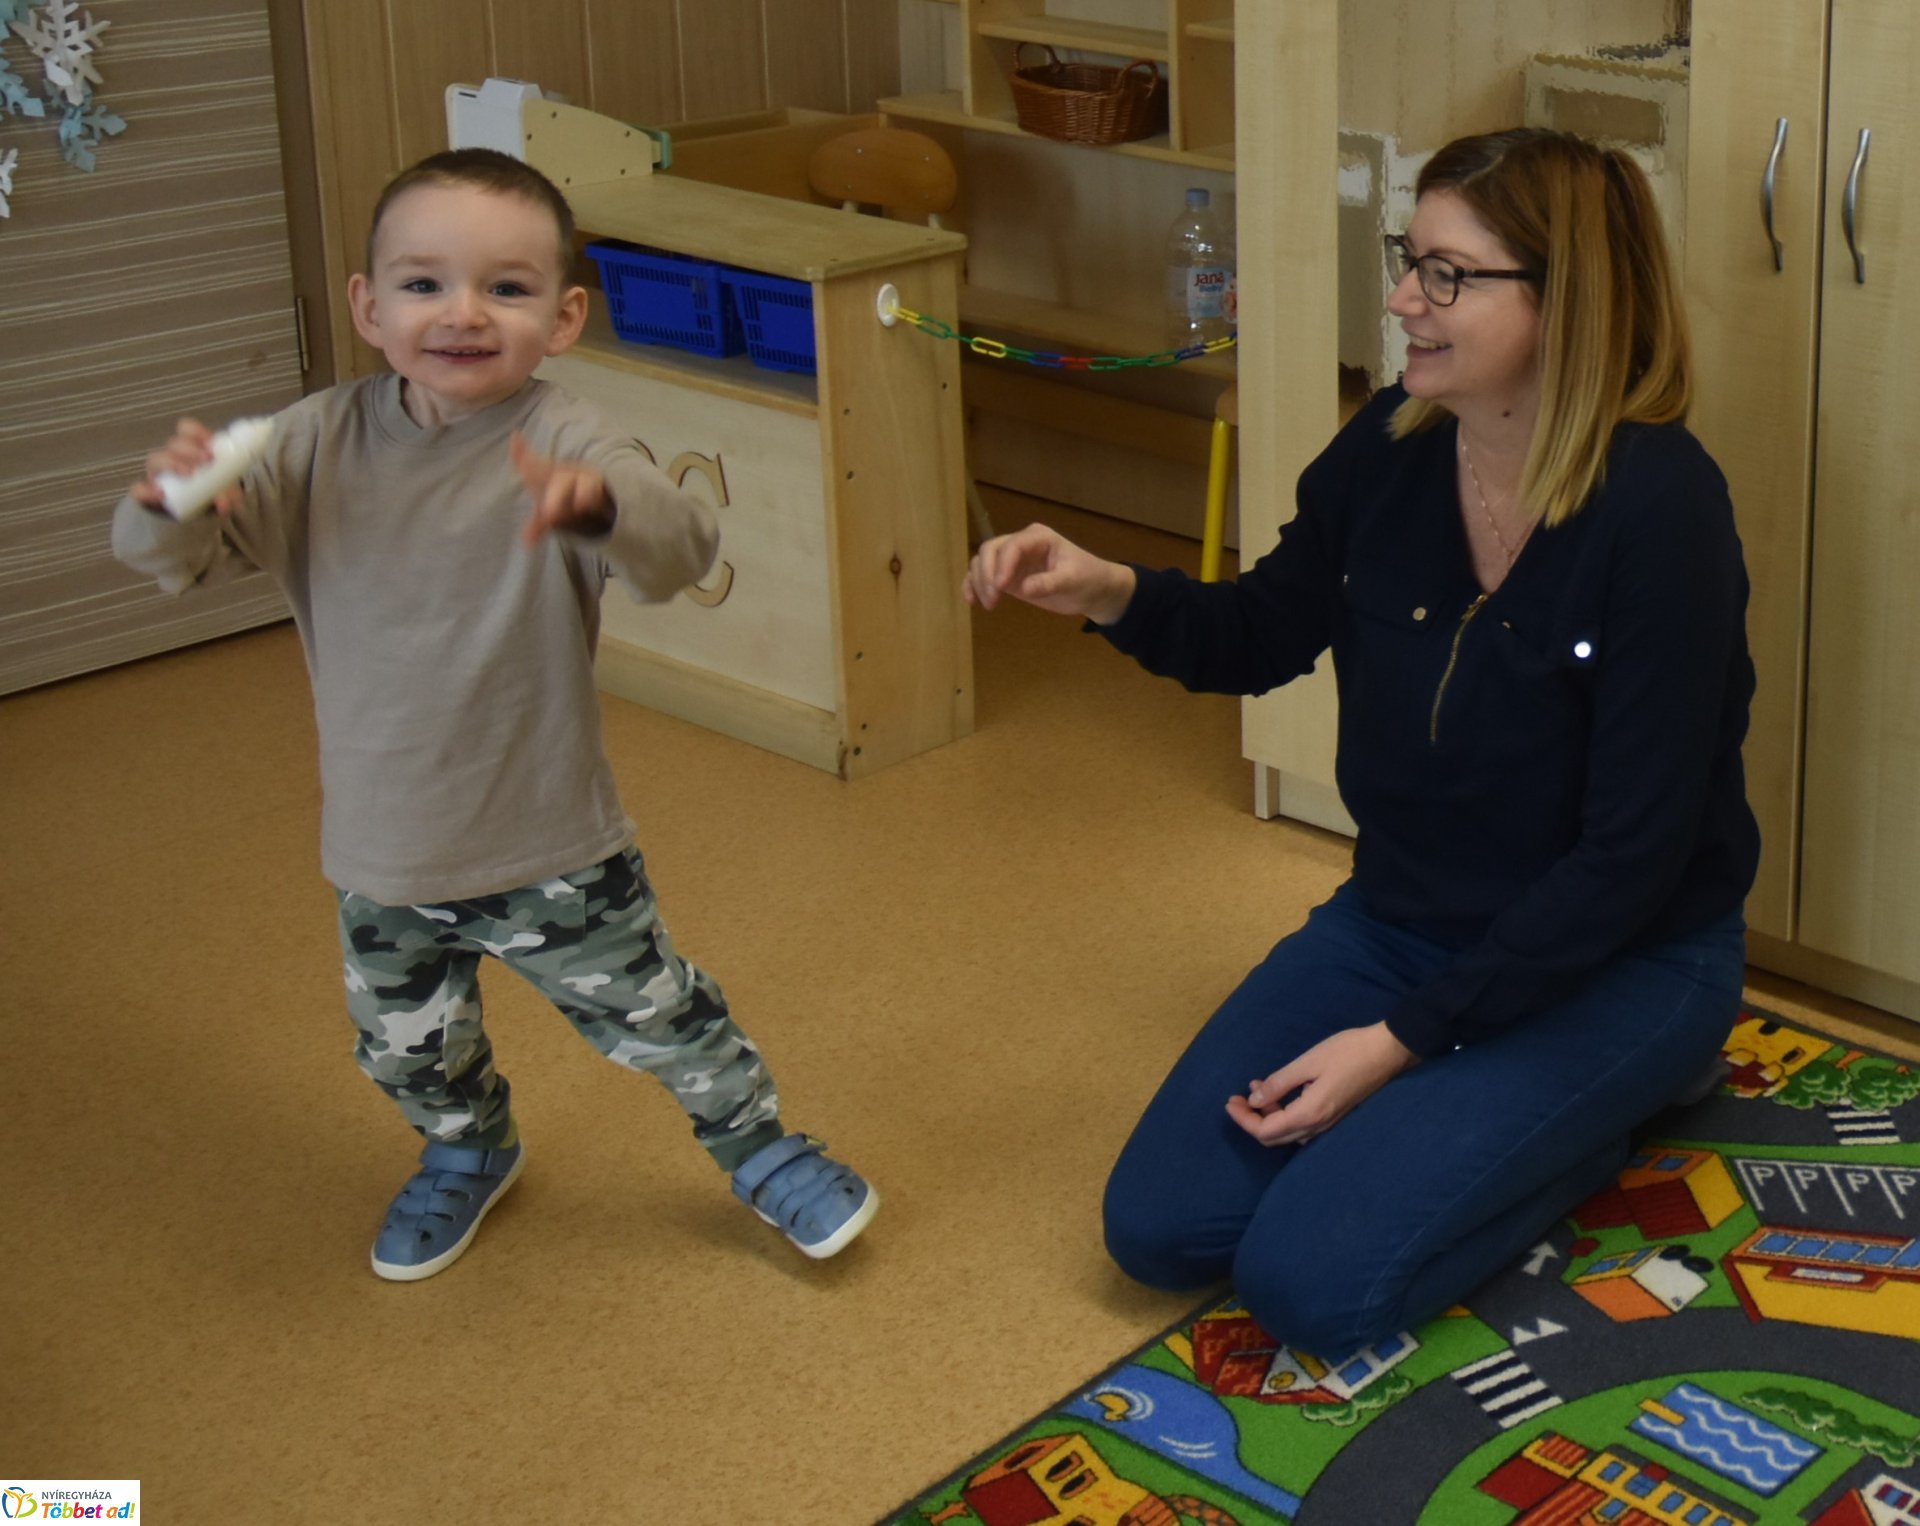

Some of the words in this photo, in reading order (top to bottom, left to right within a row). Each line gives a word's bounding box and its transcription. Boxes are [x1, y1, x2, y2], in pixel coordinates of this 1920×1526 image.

[1751, 1166, 1775, 1186] P
[1795, 1168, 1818, 1190] P
[1846, 1172, 1870, 1192] P
[1892, 1174, 1916, 1195] P
